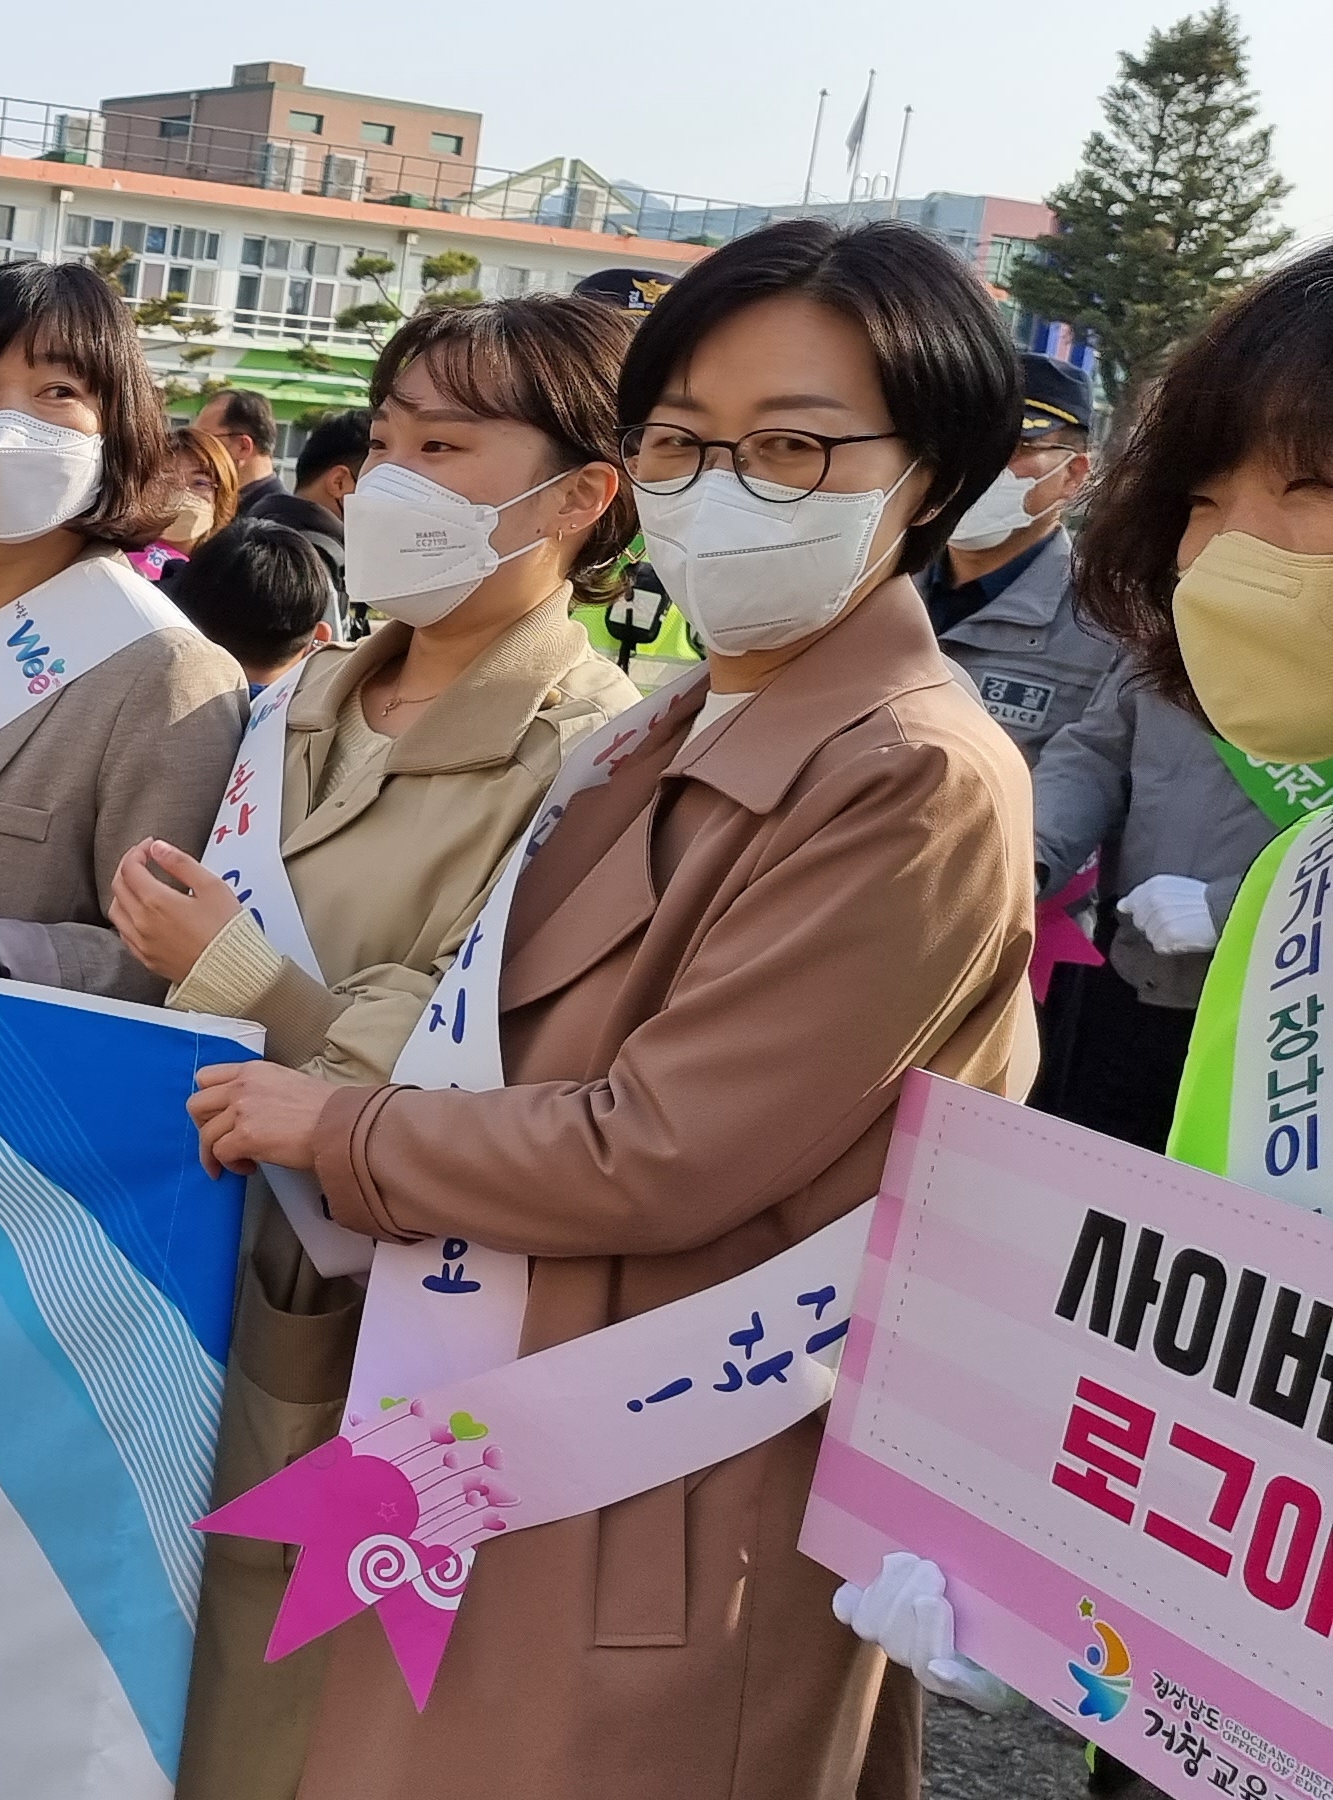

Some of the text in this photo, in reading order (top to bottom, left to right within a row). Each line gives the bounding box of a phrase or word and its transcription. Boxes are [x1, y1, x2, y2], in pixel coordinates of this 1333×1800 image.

[6, 618, 51, 695] Wee
[989, 705, 1038, 723] OLICE
[213, 758, 259, 844] 혼자
[1264, 993, 1326, 1178] 장난이
[1152, 1671, 1220, 1731] 경상남도
[1222, 1730, 1267, 1765] OFFICE
[1271, 1760, 1292, 1779] OF
[1225, 1719, 1296, 1770] GEOCHANG
